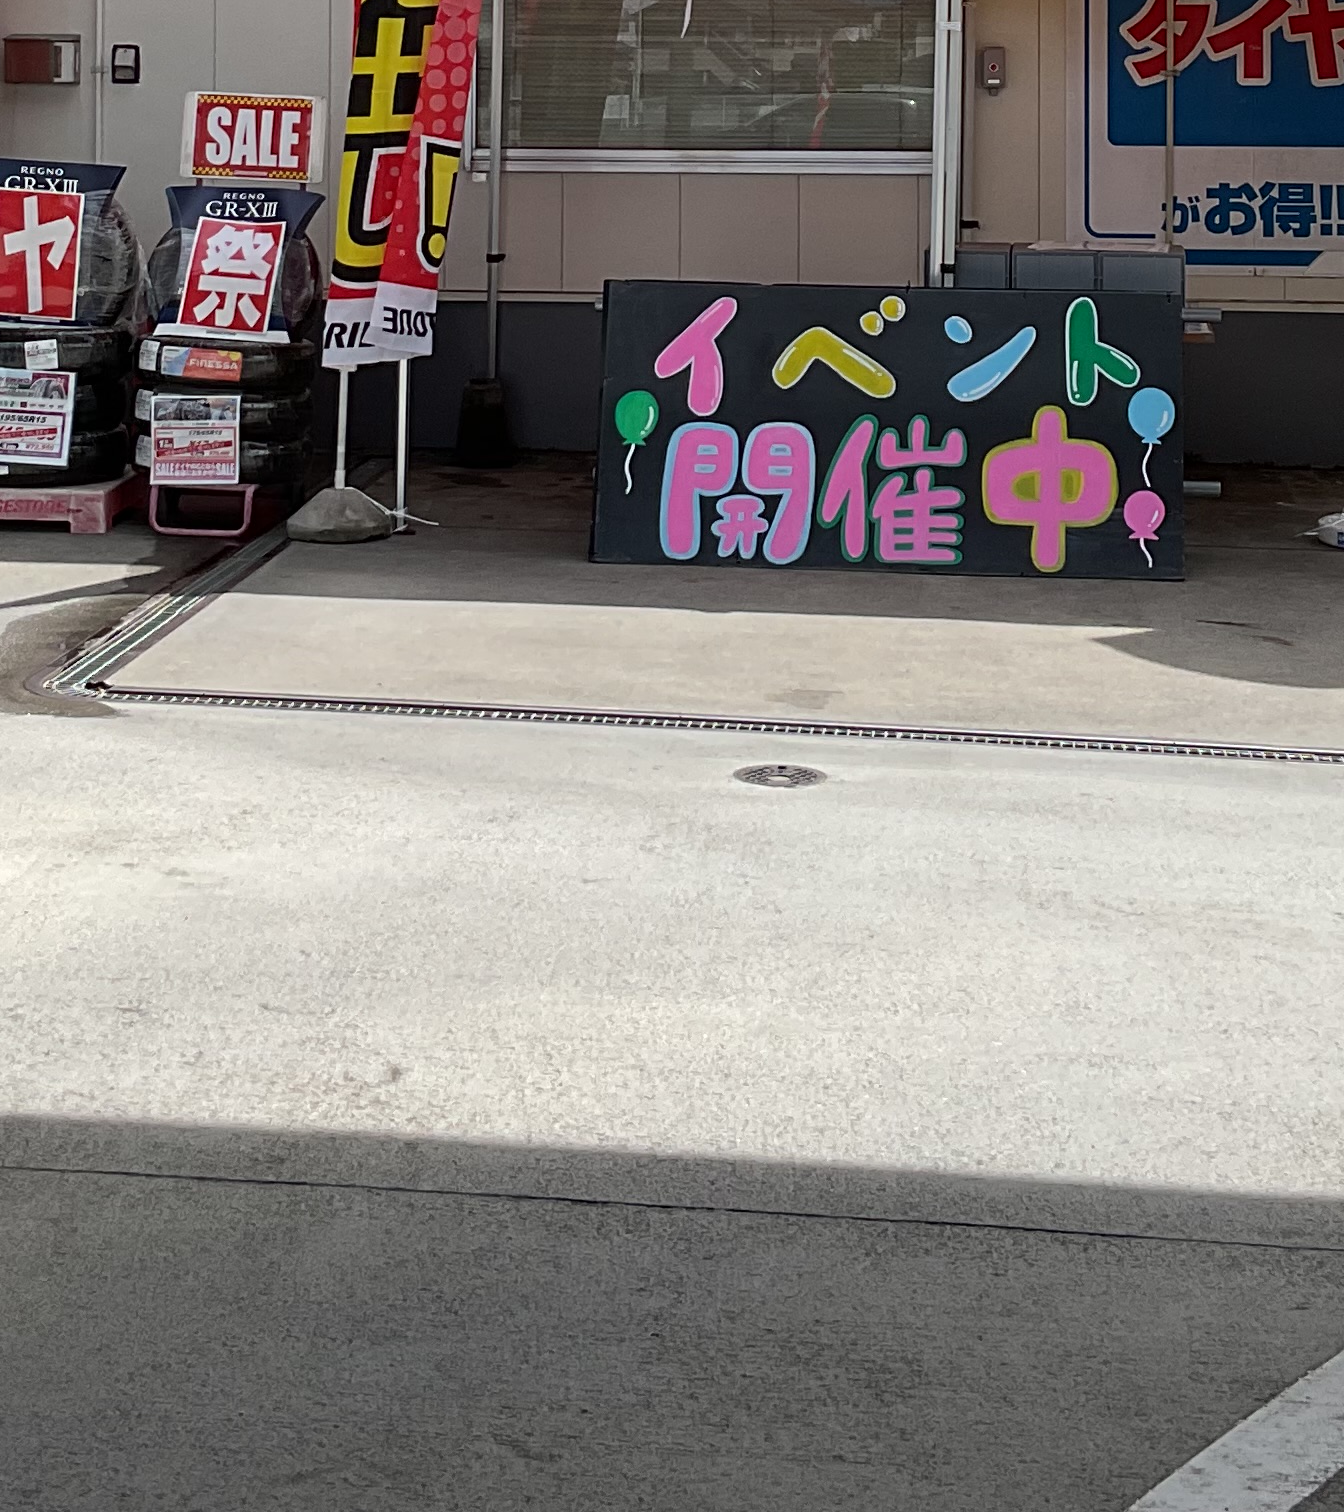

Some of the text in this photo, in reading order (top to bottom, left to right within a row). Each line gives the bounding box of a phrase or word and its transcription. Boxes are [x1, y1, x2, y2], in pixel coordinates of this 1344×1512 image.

[20, 166, 64, 177] REGNO
[205, 106, 301, 169] SALE
[222, 192, 265, 201] REGNO
[3, 195, 76, 313] ヤ
[193, 225, 275, 328] 祭
[189, 359, 238, 370] FINESSA
[655, 296, 1140, 416] イベント
[660, 405, 1119, 573] 開催中
